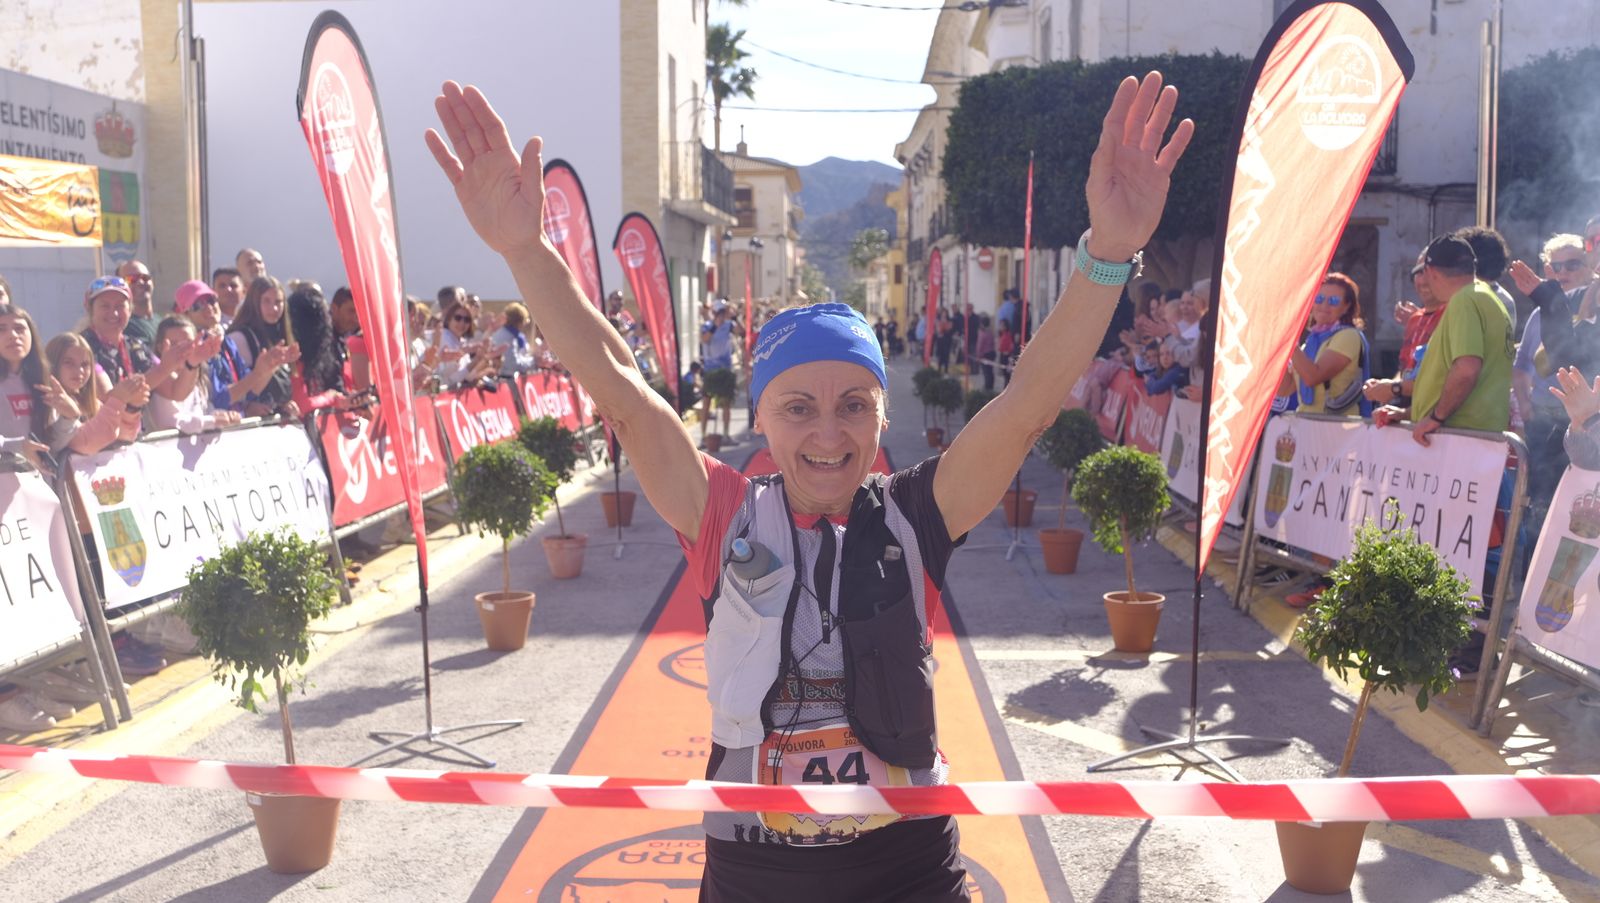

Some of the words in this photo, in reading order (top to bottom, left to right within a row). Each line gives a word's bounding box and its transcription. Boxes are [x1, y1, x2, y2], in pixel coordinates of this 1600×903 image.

[148, 459, 285, 498] AYUNTAMENT
[1449, 478, 1479, 504] DE
[154, 477, 319, 549] CANTORIA
[1293, 479, 1474, 559] CANTORIA
[802, 751, 871, 785] 44
